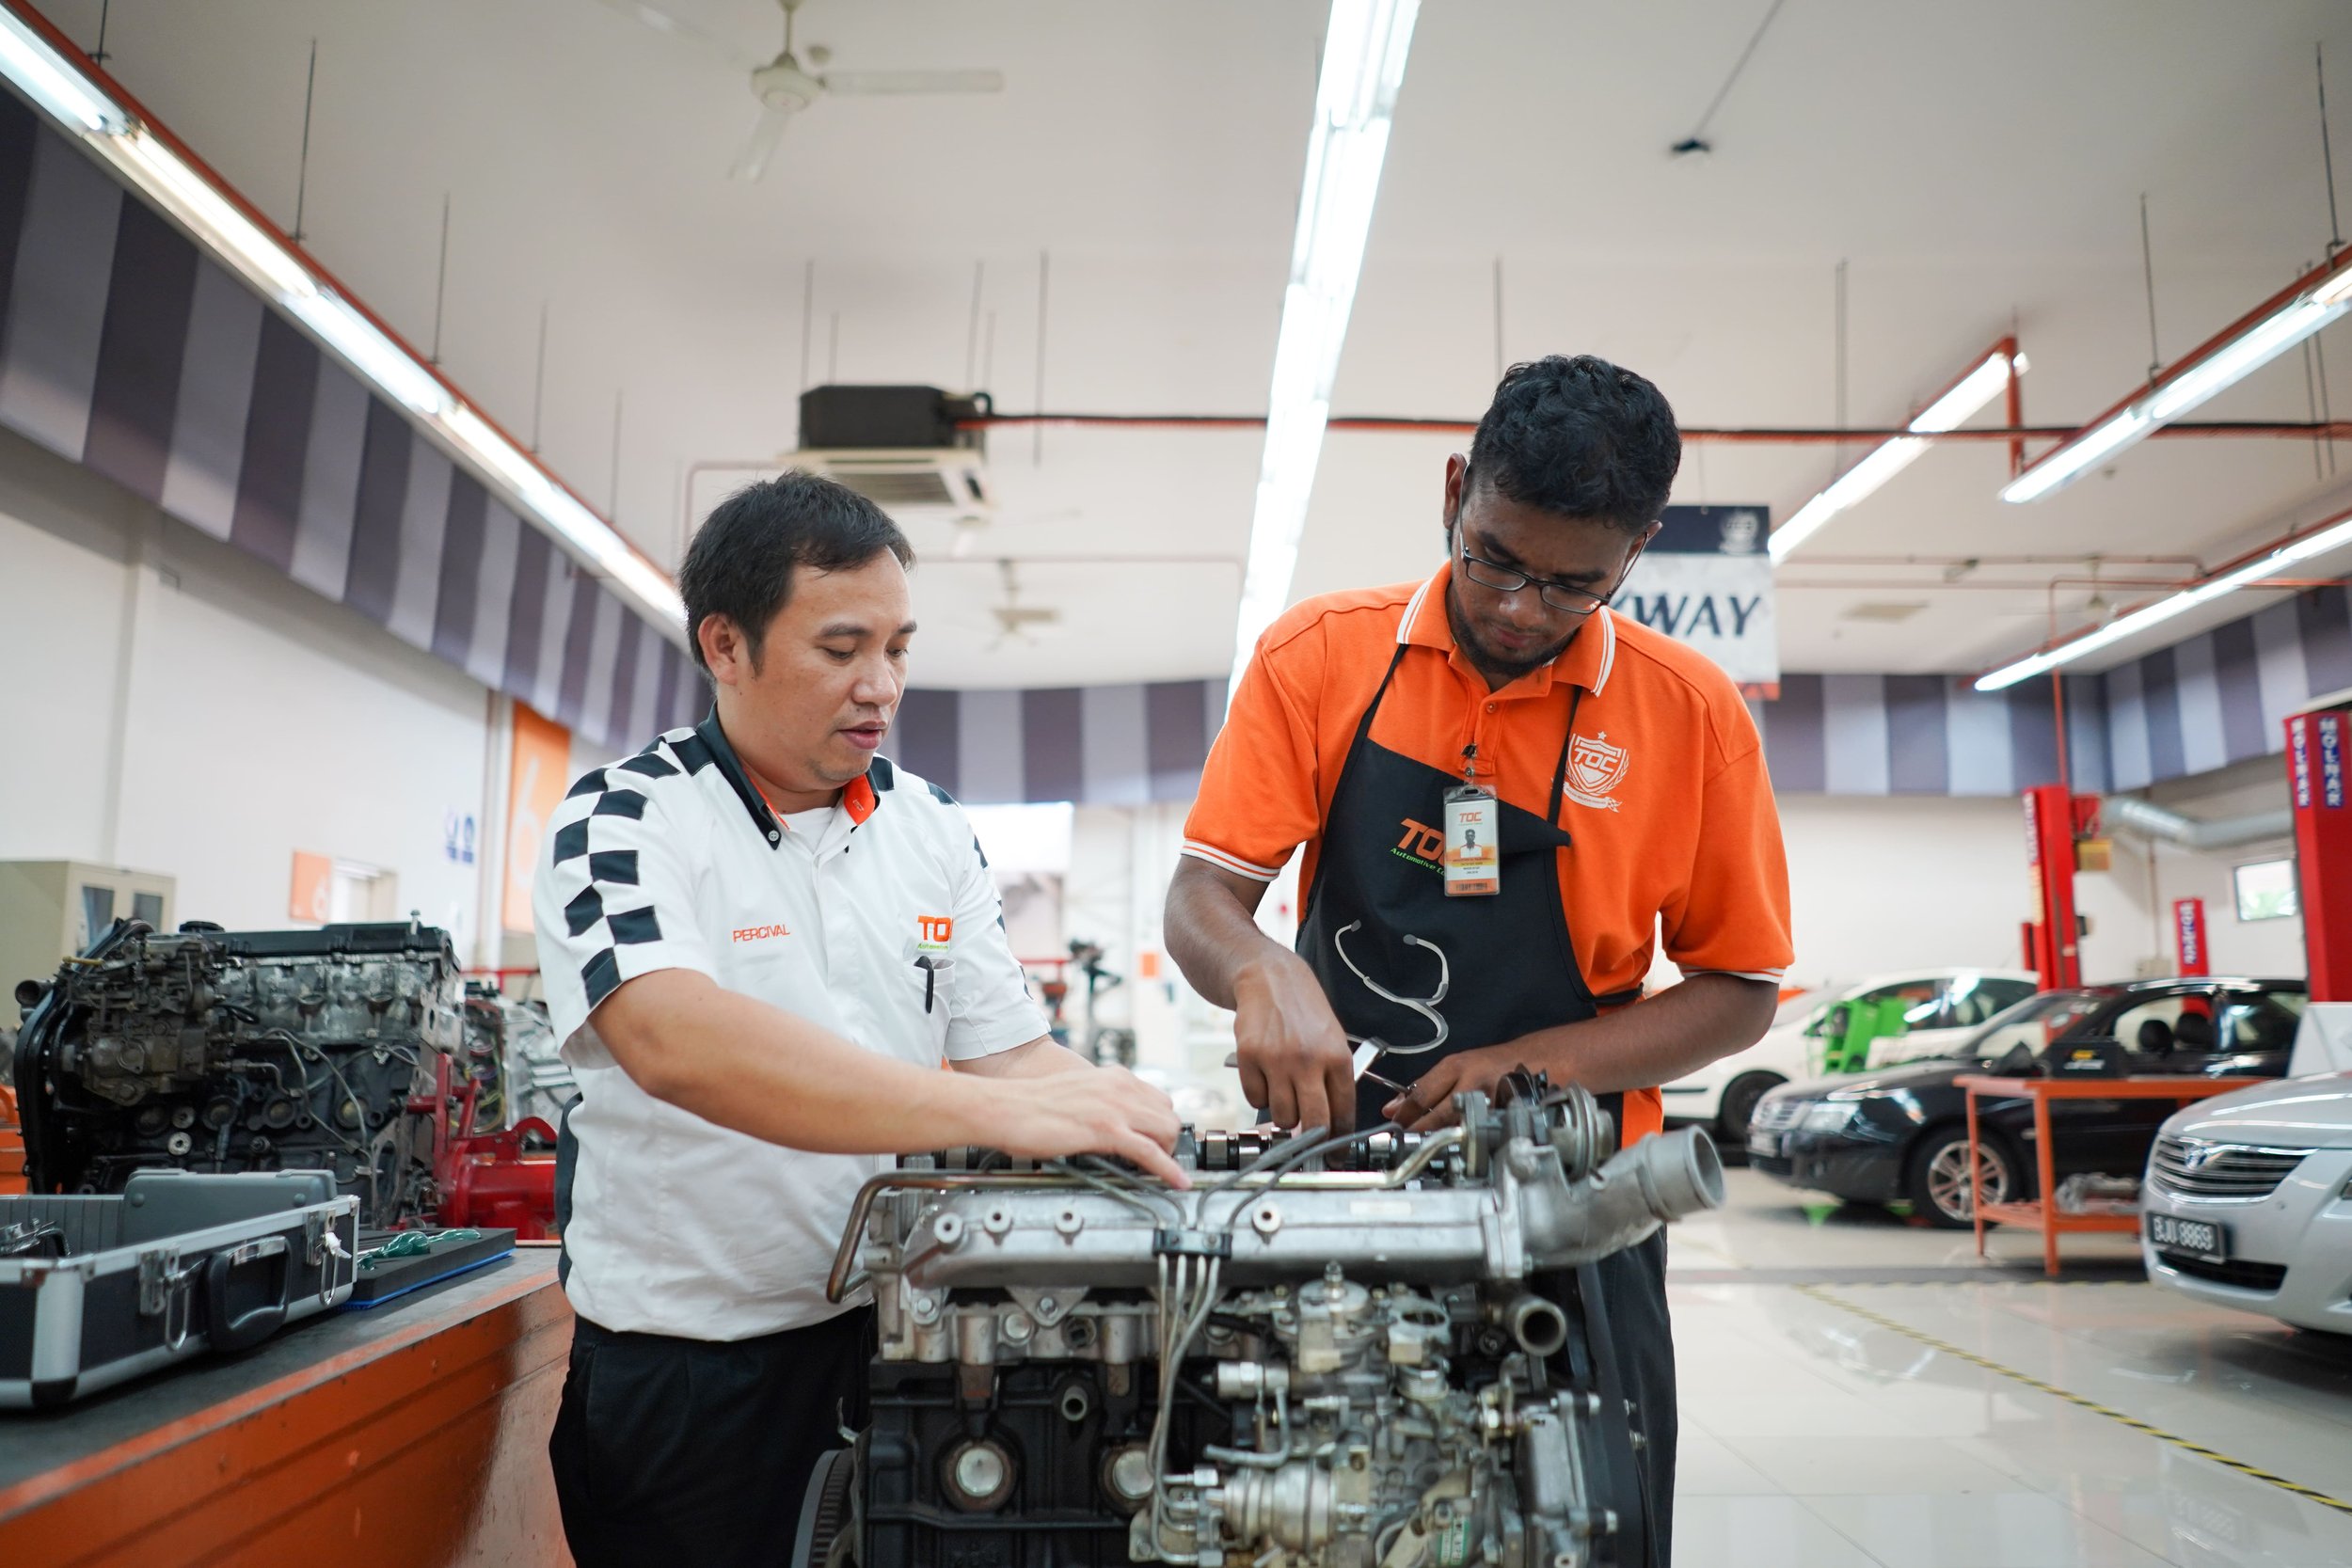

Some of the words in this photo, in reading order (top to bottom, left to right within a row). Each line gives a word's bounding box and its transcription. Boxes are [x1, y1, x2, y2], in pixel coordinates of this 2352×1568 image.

[1574, 748, 1618, 773] TOC
[1459, 812, 1483, 823] TOC
[1397, 817, 1445, 866] TO
[1391, 847, 1436, 870] Automotive
[732, 924, 791, 942] PERCIVAL
[917, 915, 953, 942] TO
